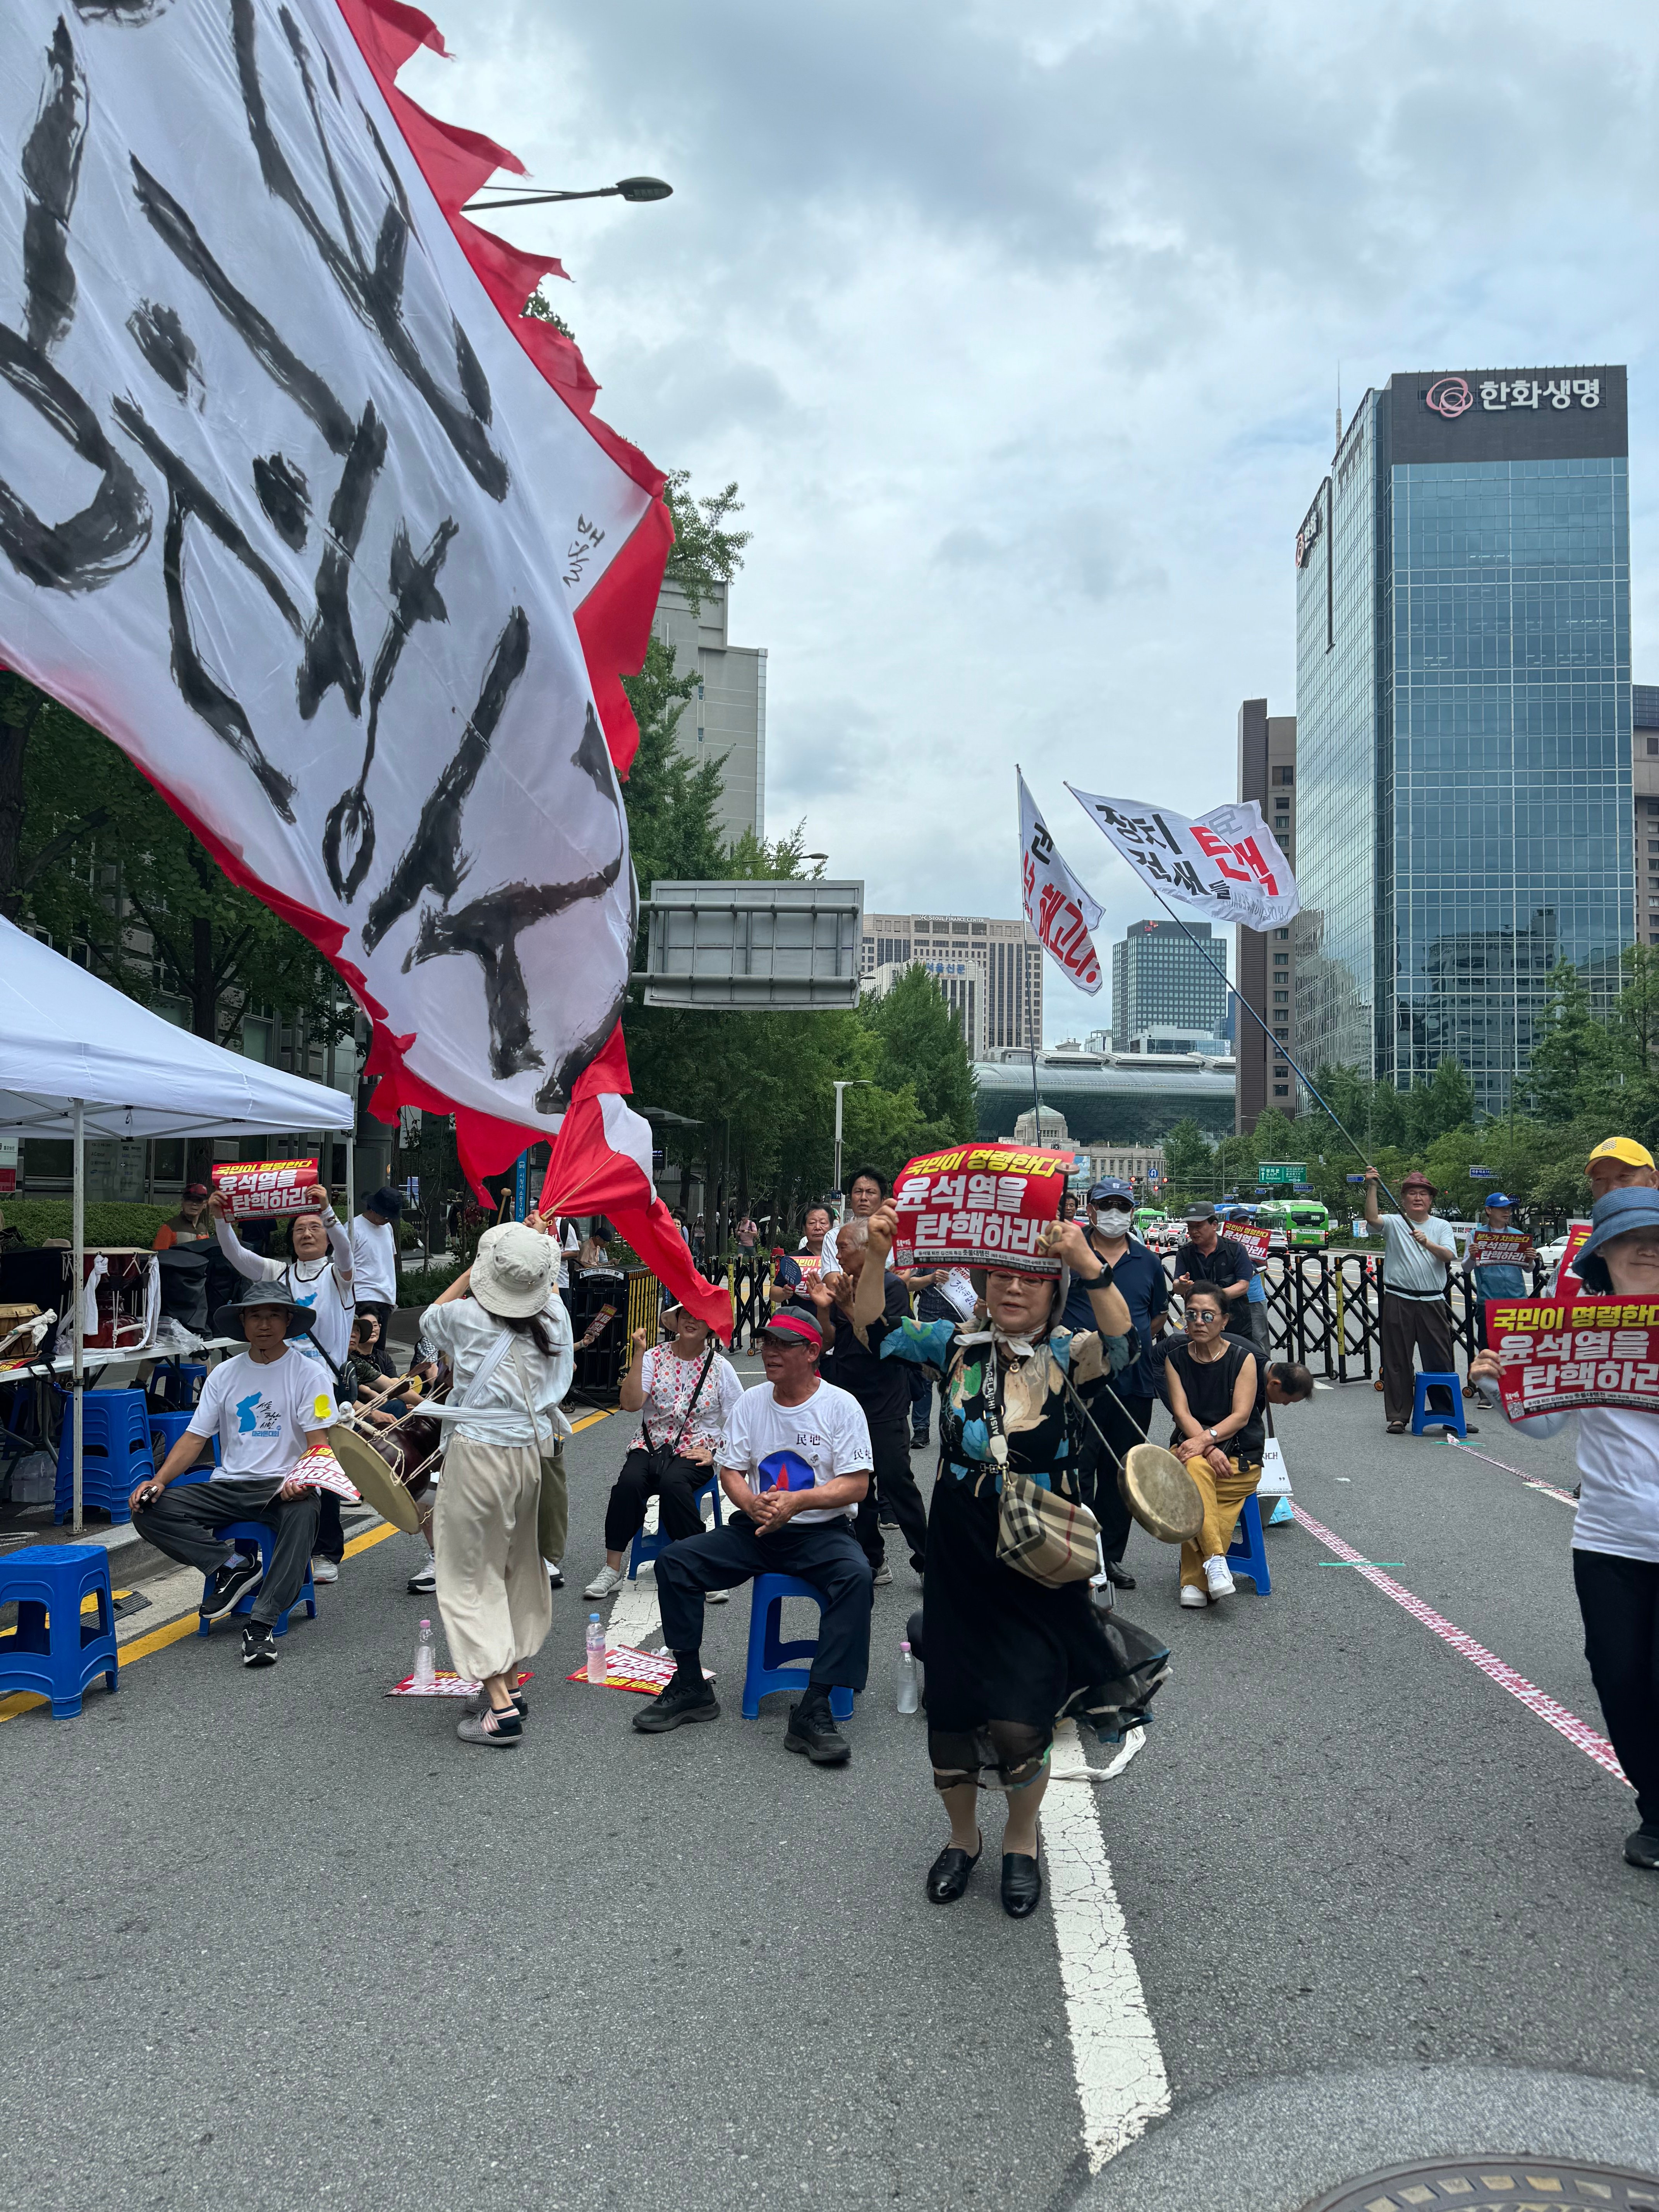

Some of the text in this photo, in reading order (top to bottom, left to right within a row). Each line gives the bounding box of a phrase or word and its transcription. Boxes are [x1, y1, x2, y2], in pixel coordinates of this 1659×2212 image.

[1479, 379, 1600, 410] 한화생명
[1095, 805, 1183, 854] 정치
[1189, 826, 1279, 896] 탄핵
[216, 1160, 313, 1175] 국민이 명령한다
[905, 1149, 1062, 1178] 국민이 명령한다
[219, 1170, 298, 1195] 윤석열을
[895, 1174, 1028, 1213] 윤석열을
[1223, 1230, 1261, 1245] 윤석열을
[1225, 1223, 1269, 1238] 국민이 명령한다
[1477, 1241, 1520, 1251] 윤석열을
[1480, 1250, 1526, 1262] 탄핵하라!
[1493, 1307, 1565, 1331] 국민이
[1498, 1331, 1650, 1366] 윤석열을
[256, 1401, 272, 1413] 서울
